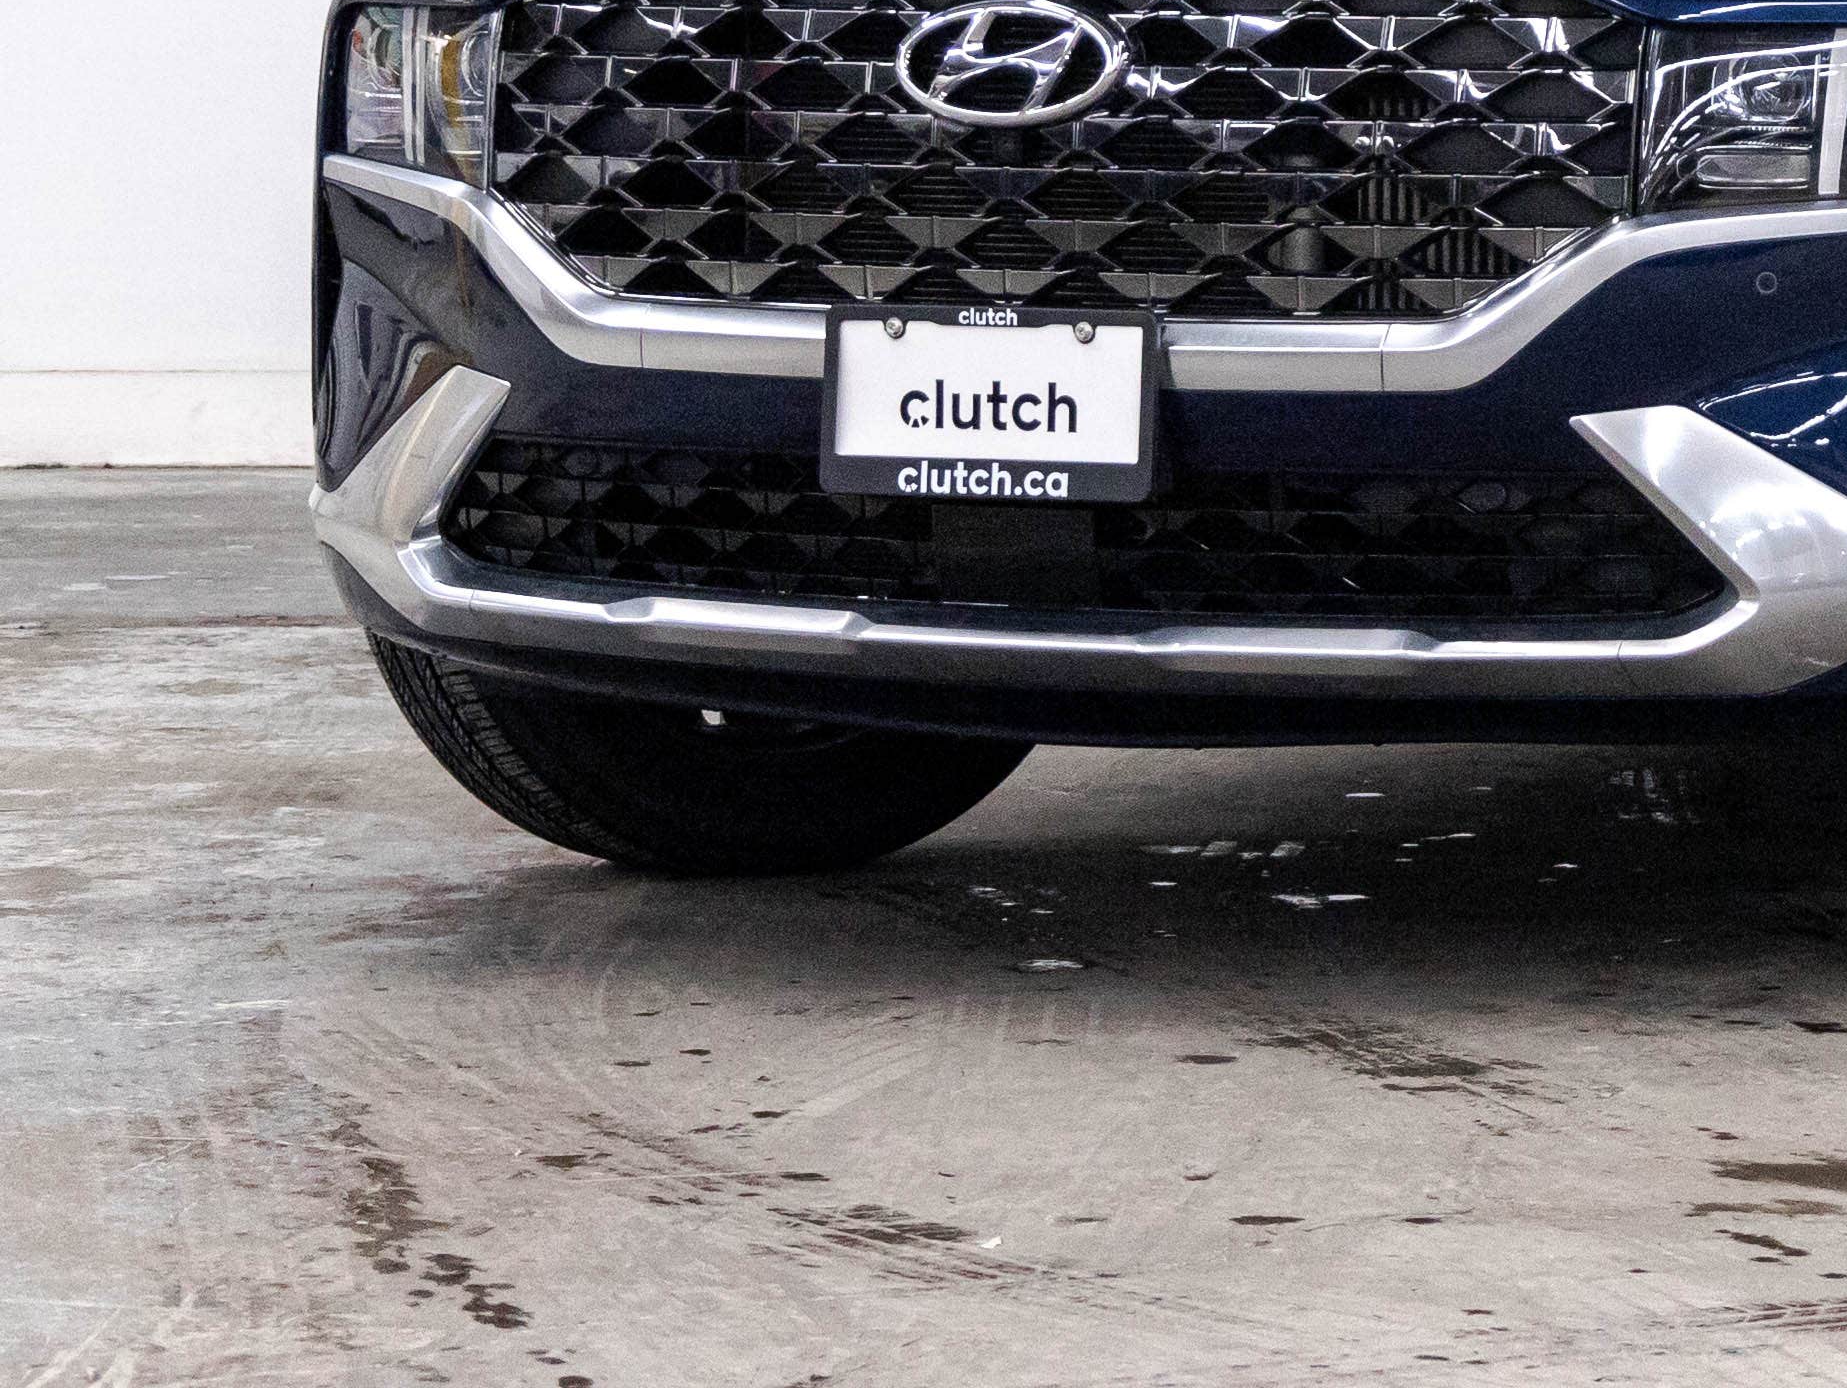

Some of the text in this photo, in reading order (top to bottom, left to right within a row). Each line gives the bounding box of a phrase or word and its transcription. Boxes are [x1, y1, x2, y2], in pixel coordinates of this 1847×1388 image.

[958, 308, 1018, 326] clutch
[900, 379, 1078, 433] clutch
[897, 460, 1069, 498] clutch.ca
